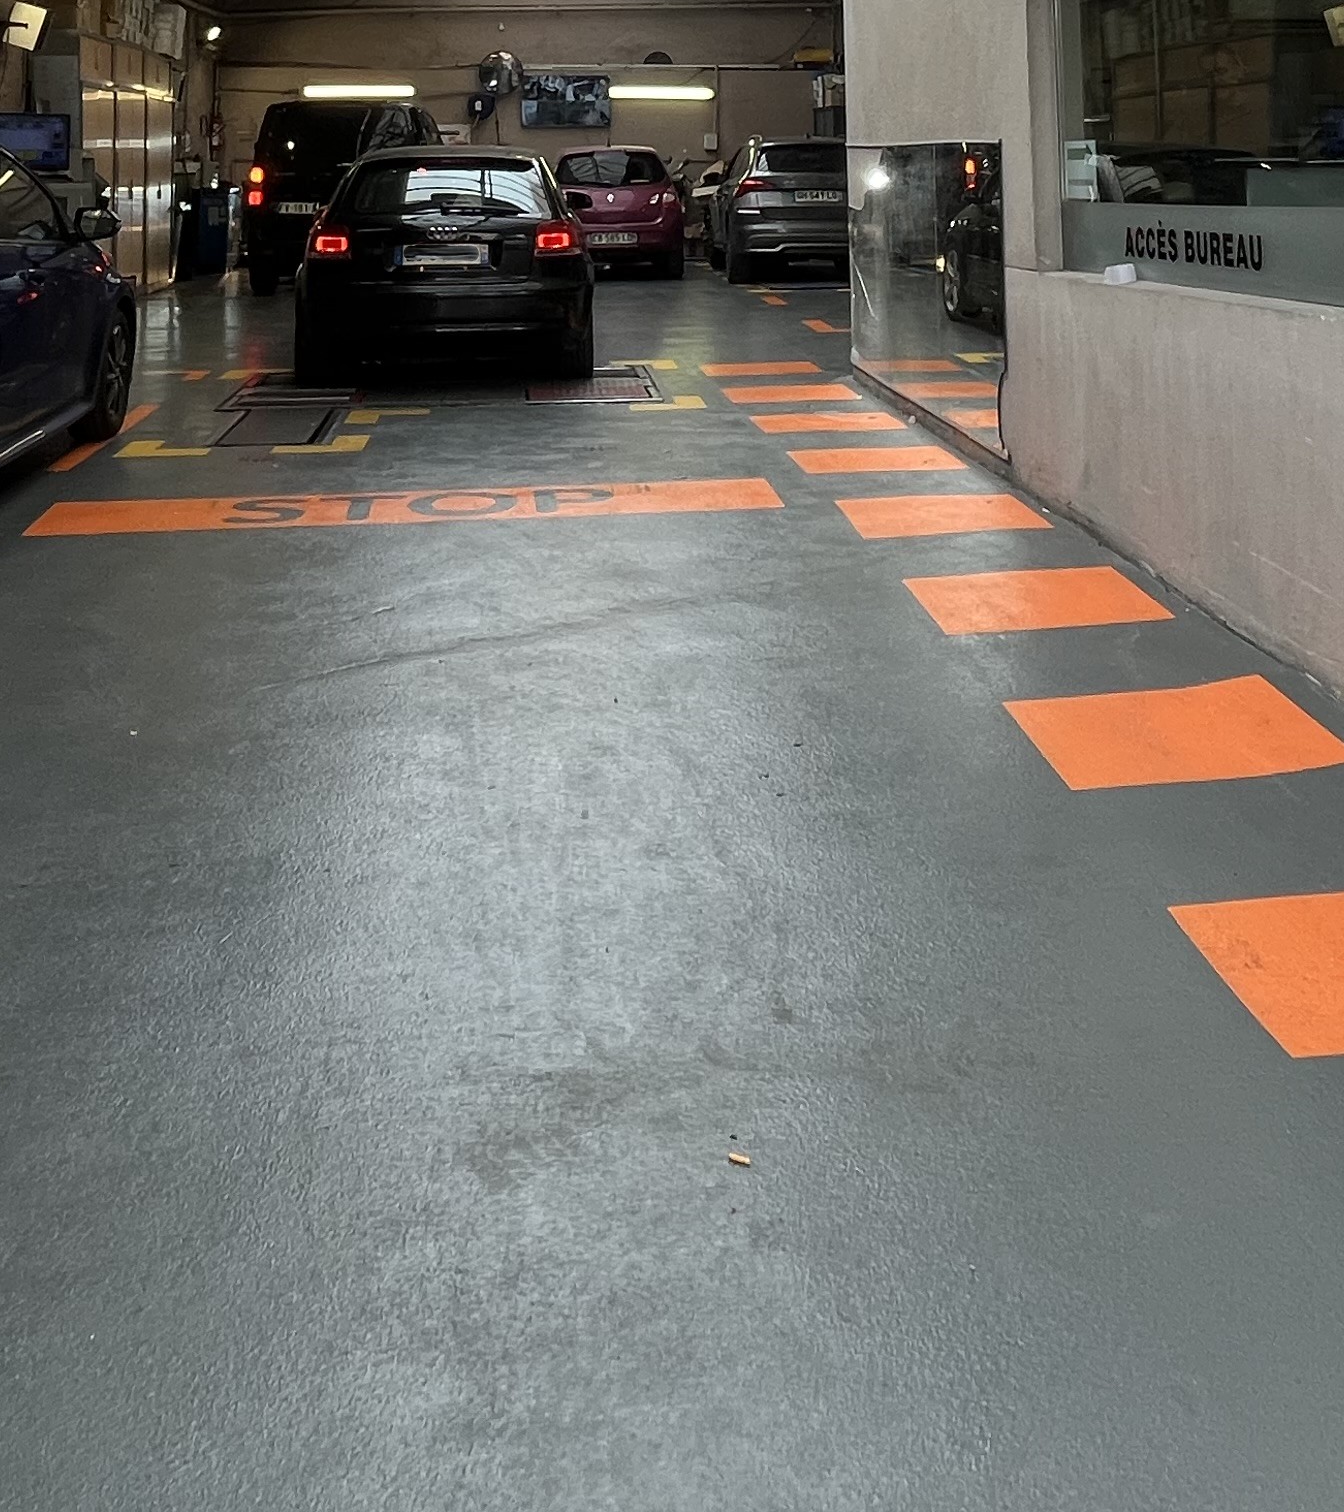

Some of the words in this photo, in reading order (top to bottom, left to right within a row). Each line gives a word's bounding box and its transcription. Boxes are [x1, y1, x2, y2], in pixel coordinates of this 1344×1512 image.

[1124, 220, 1178, 263] ACCÈS
[1183, 229, 1263, 271] BUREAU
[222, 488, 614, 524] STOP
